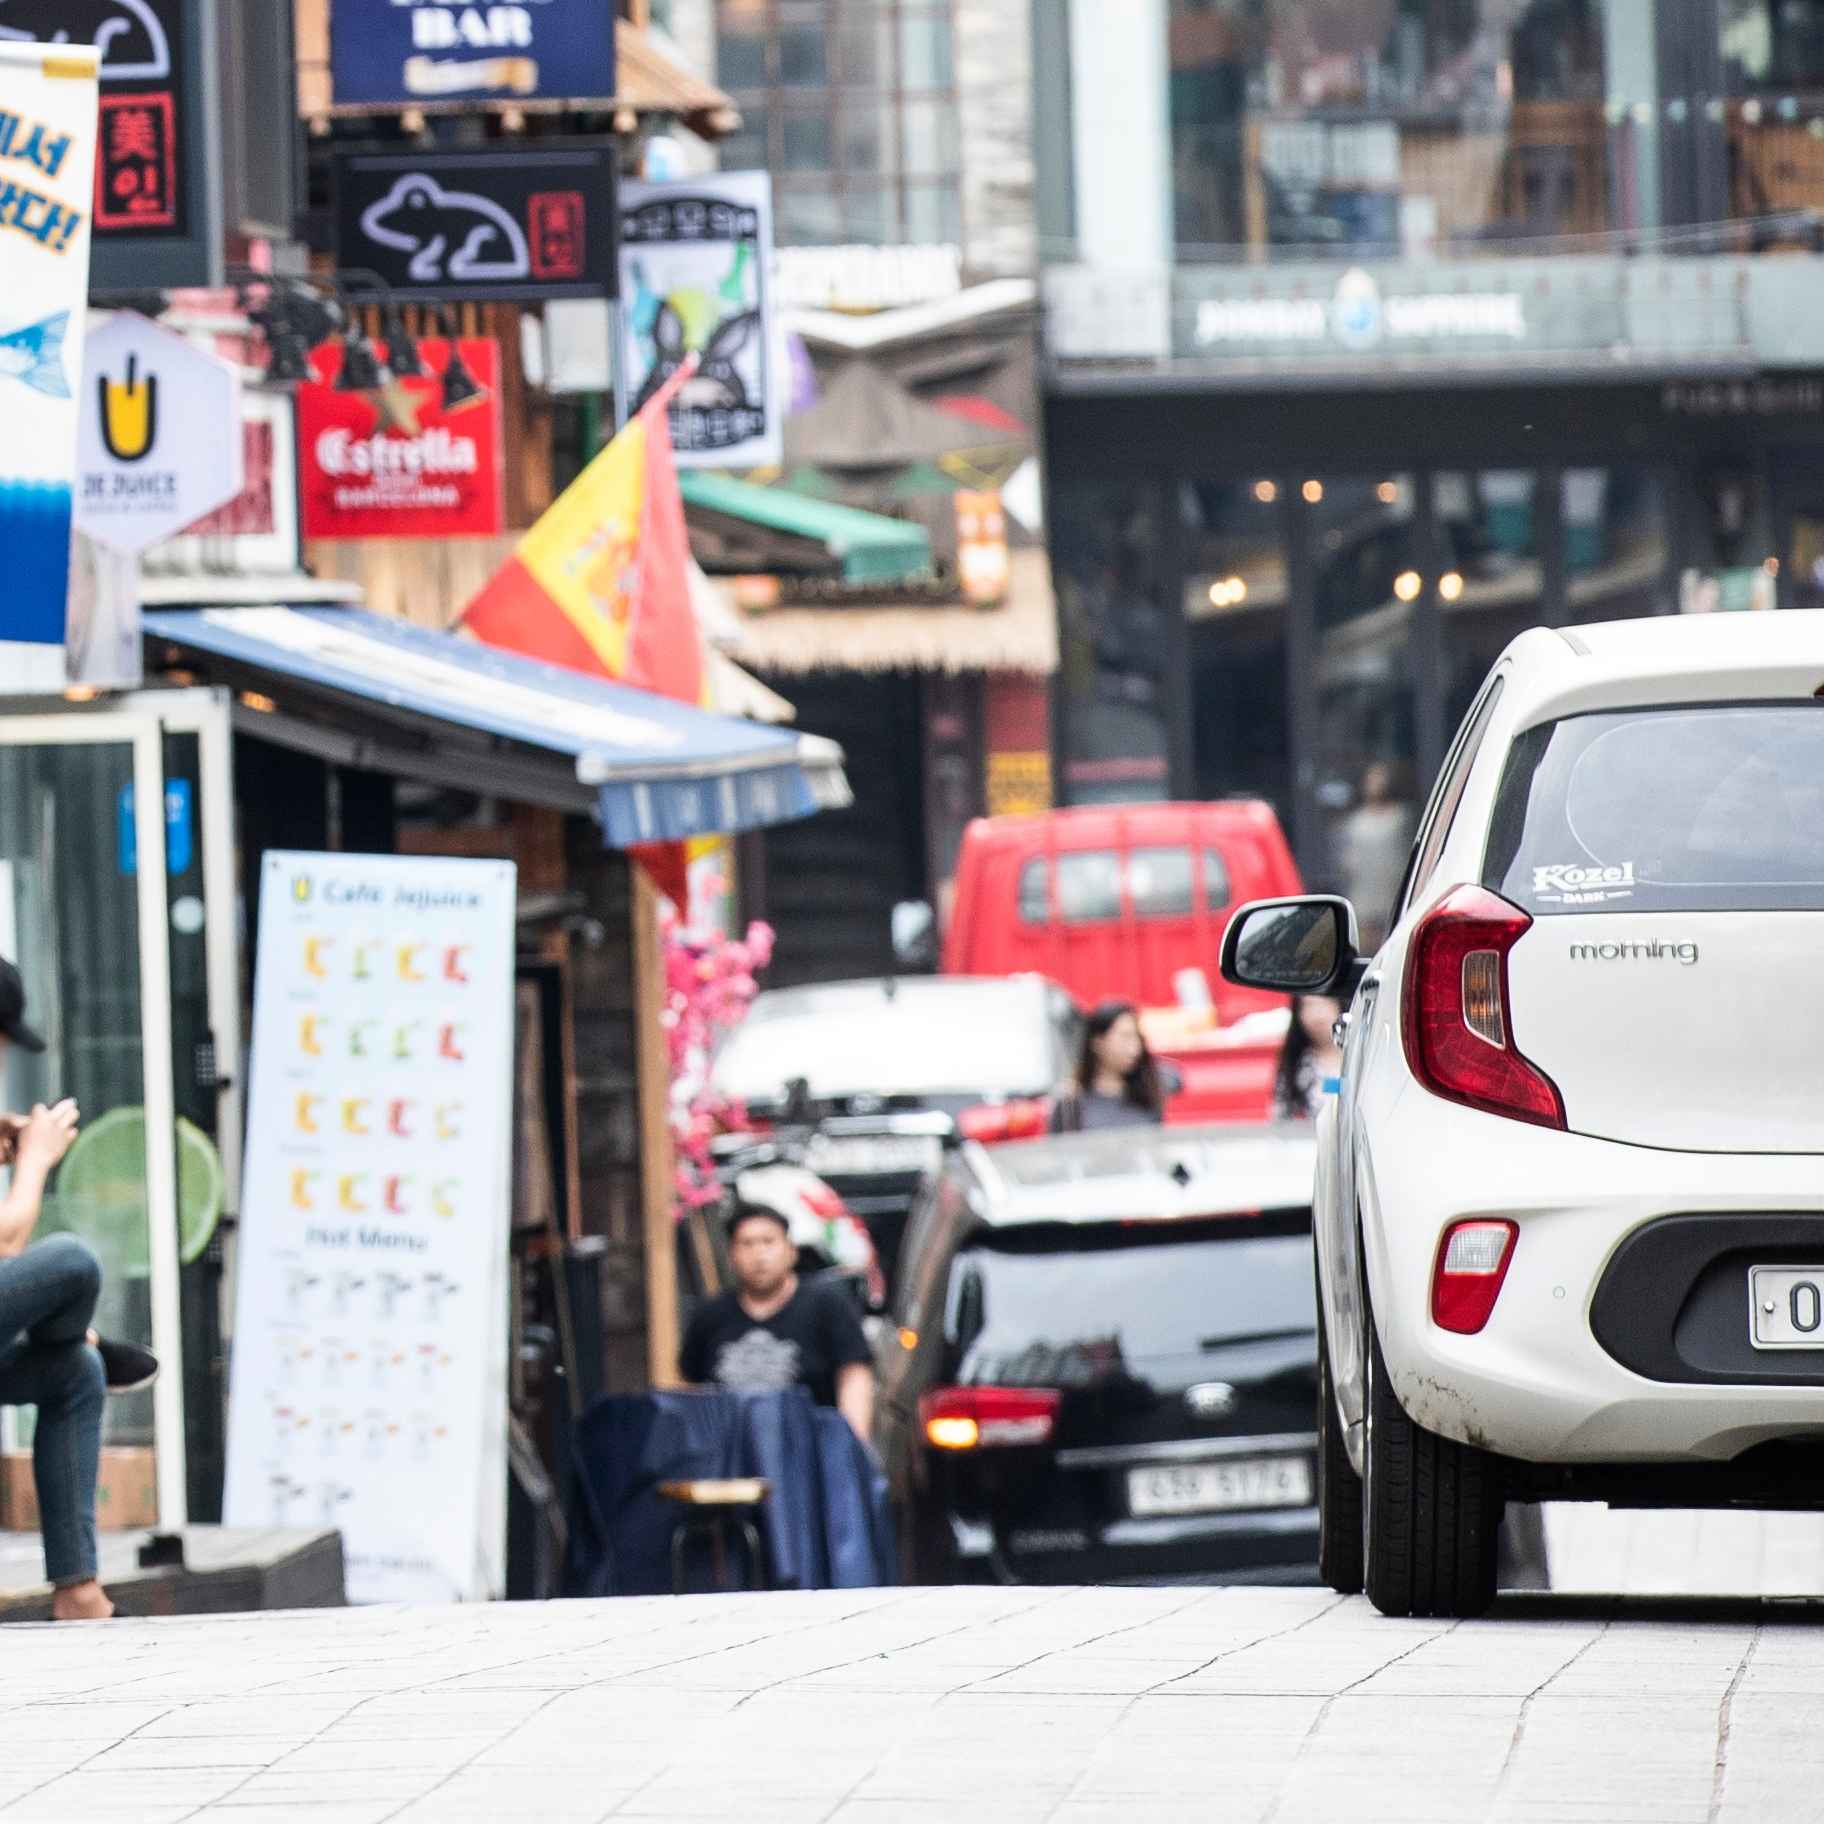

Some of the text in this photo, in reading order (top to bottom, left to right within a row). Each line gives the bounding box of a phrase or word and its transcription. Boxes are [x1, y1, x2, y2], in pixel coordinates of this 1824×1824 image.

[412, 6, 533, 48] BAR
[316, 427, 477, 476] Estrella
[1533, 860, 1636, 894] Kozel
[1563, 890, 1605, 904] DARK
[1569, 937, 1698, 964] morning
[1789, 1280, 1821, 1332] 0
